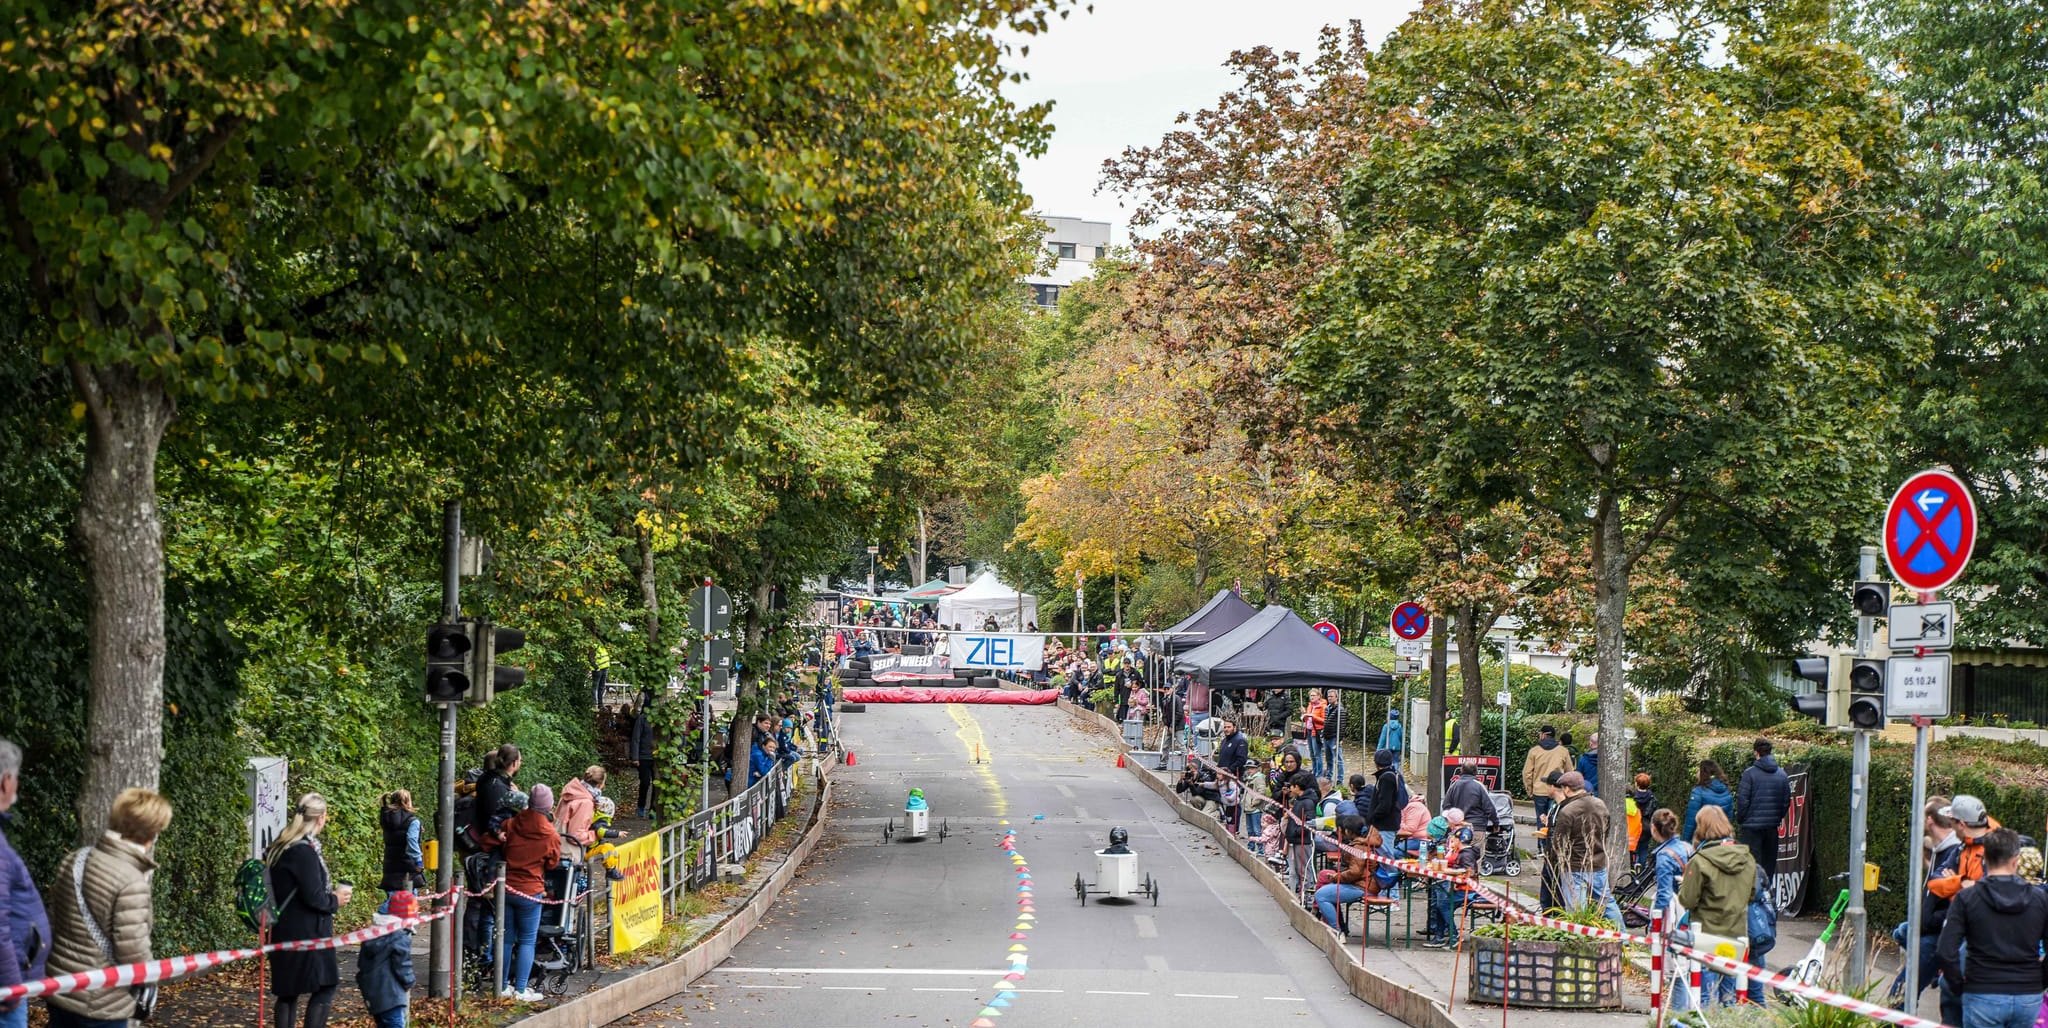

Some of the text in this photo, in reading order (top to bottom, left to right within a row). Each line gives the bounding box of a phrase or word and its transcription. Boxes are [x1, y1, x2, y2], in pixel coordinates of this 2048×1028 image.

[965, 637, 1024, 666] ZIEL
[1904, 676, 1936, 686] 05.10.24
[1915, 690, 1928, 698] Uhr
